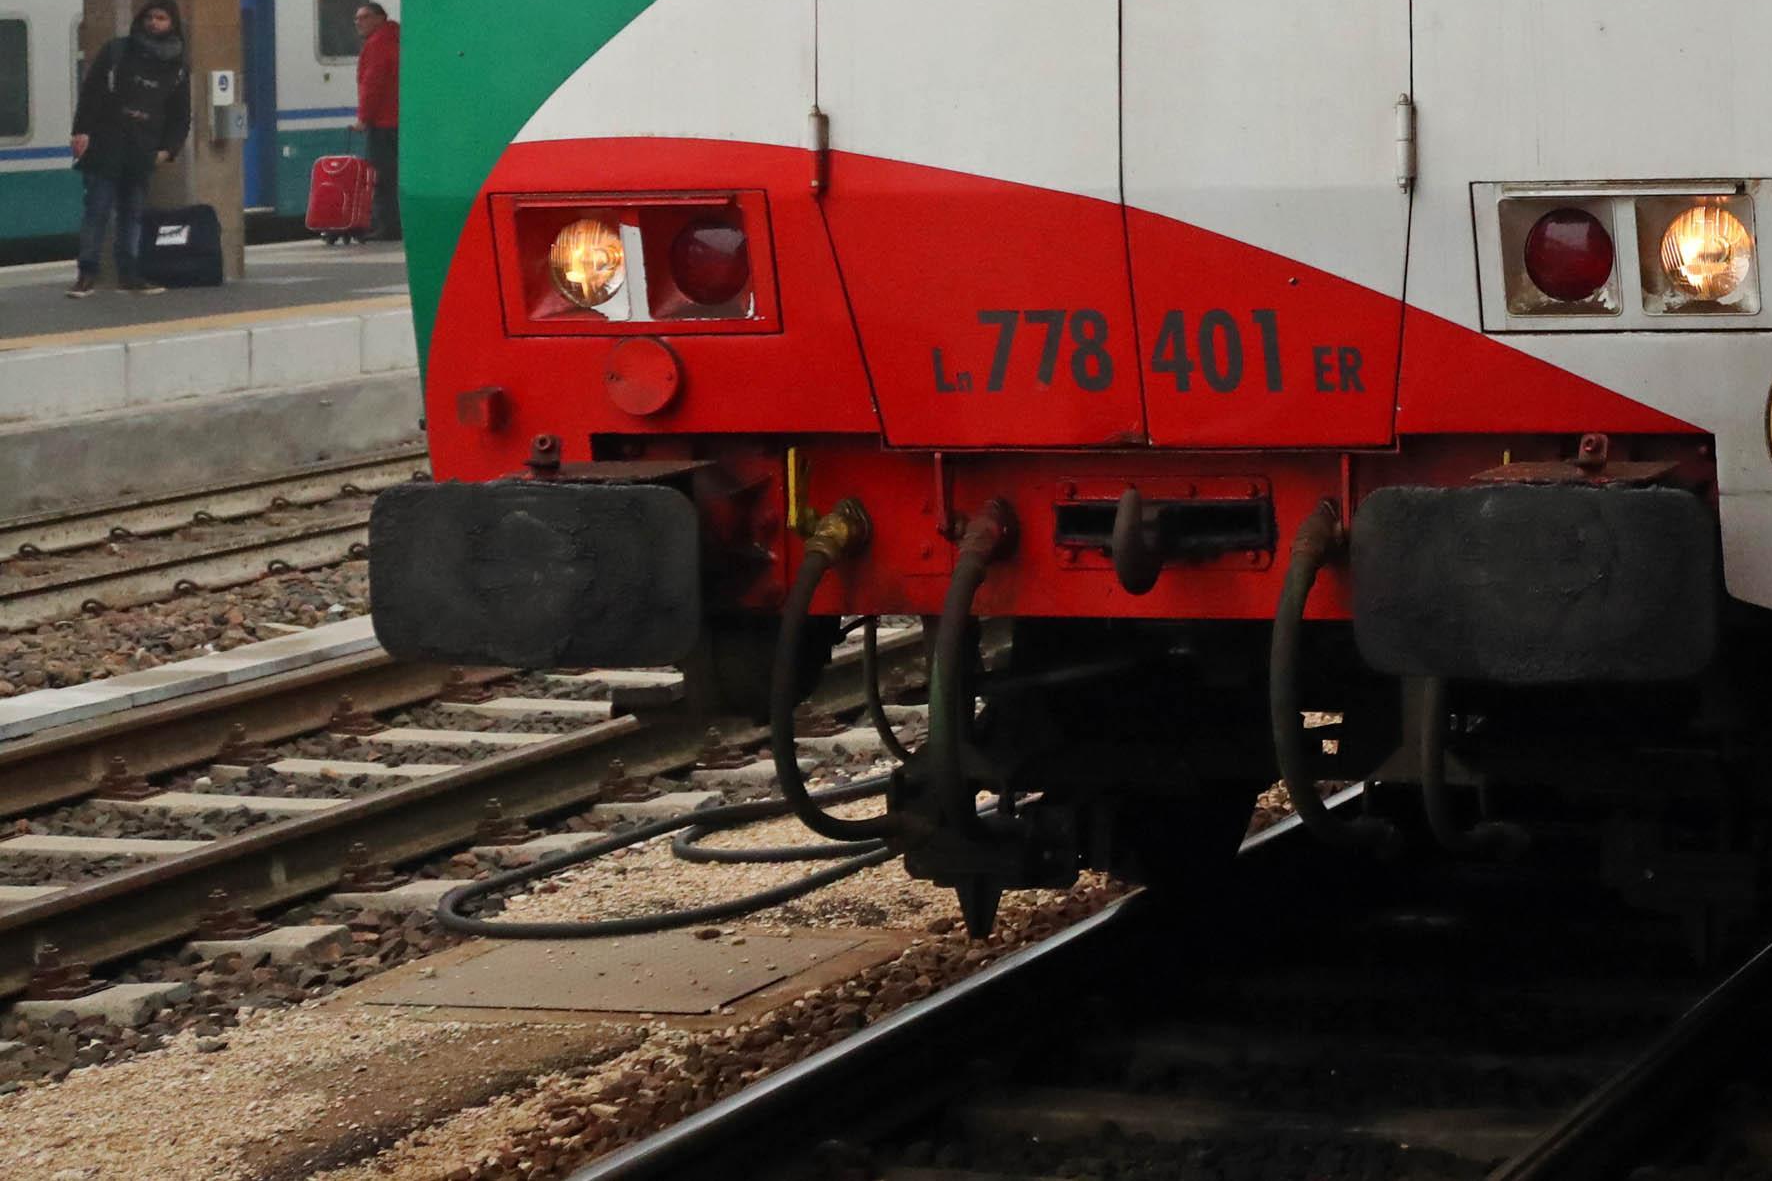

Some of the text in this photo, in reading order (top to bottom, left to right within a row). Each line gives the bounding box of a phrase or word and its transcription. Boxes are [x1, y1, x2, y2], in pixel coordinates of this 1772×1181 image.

[977, 308, 1114, 393] 778
[1151, 309, 1284, 393] 401
[1312, 346, 1366, 393] ER
